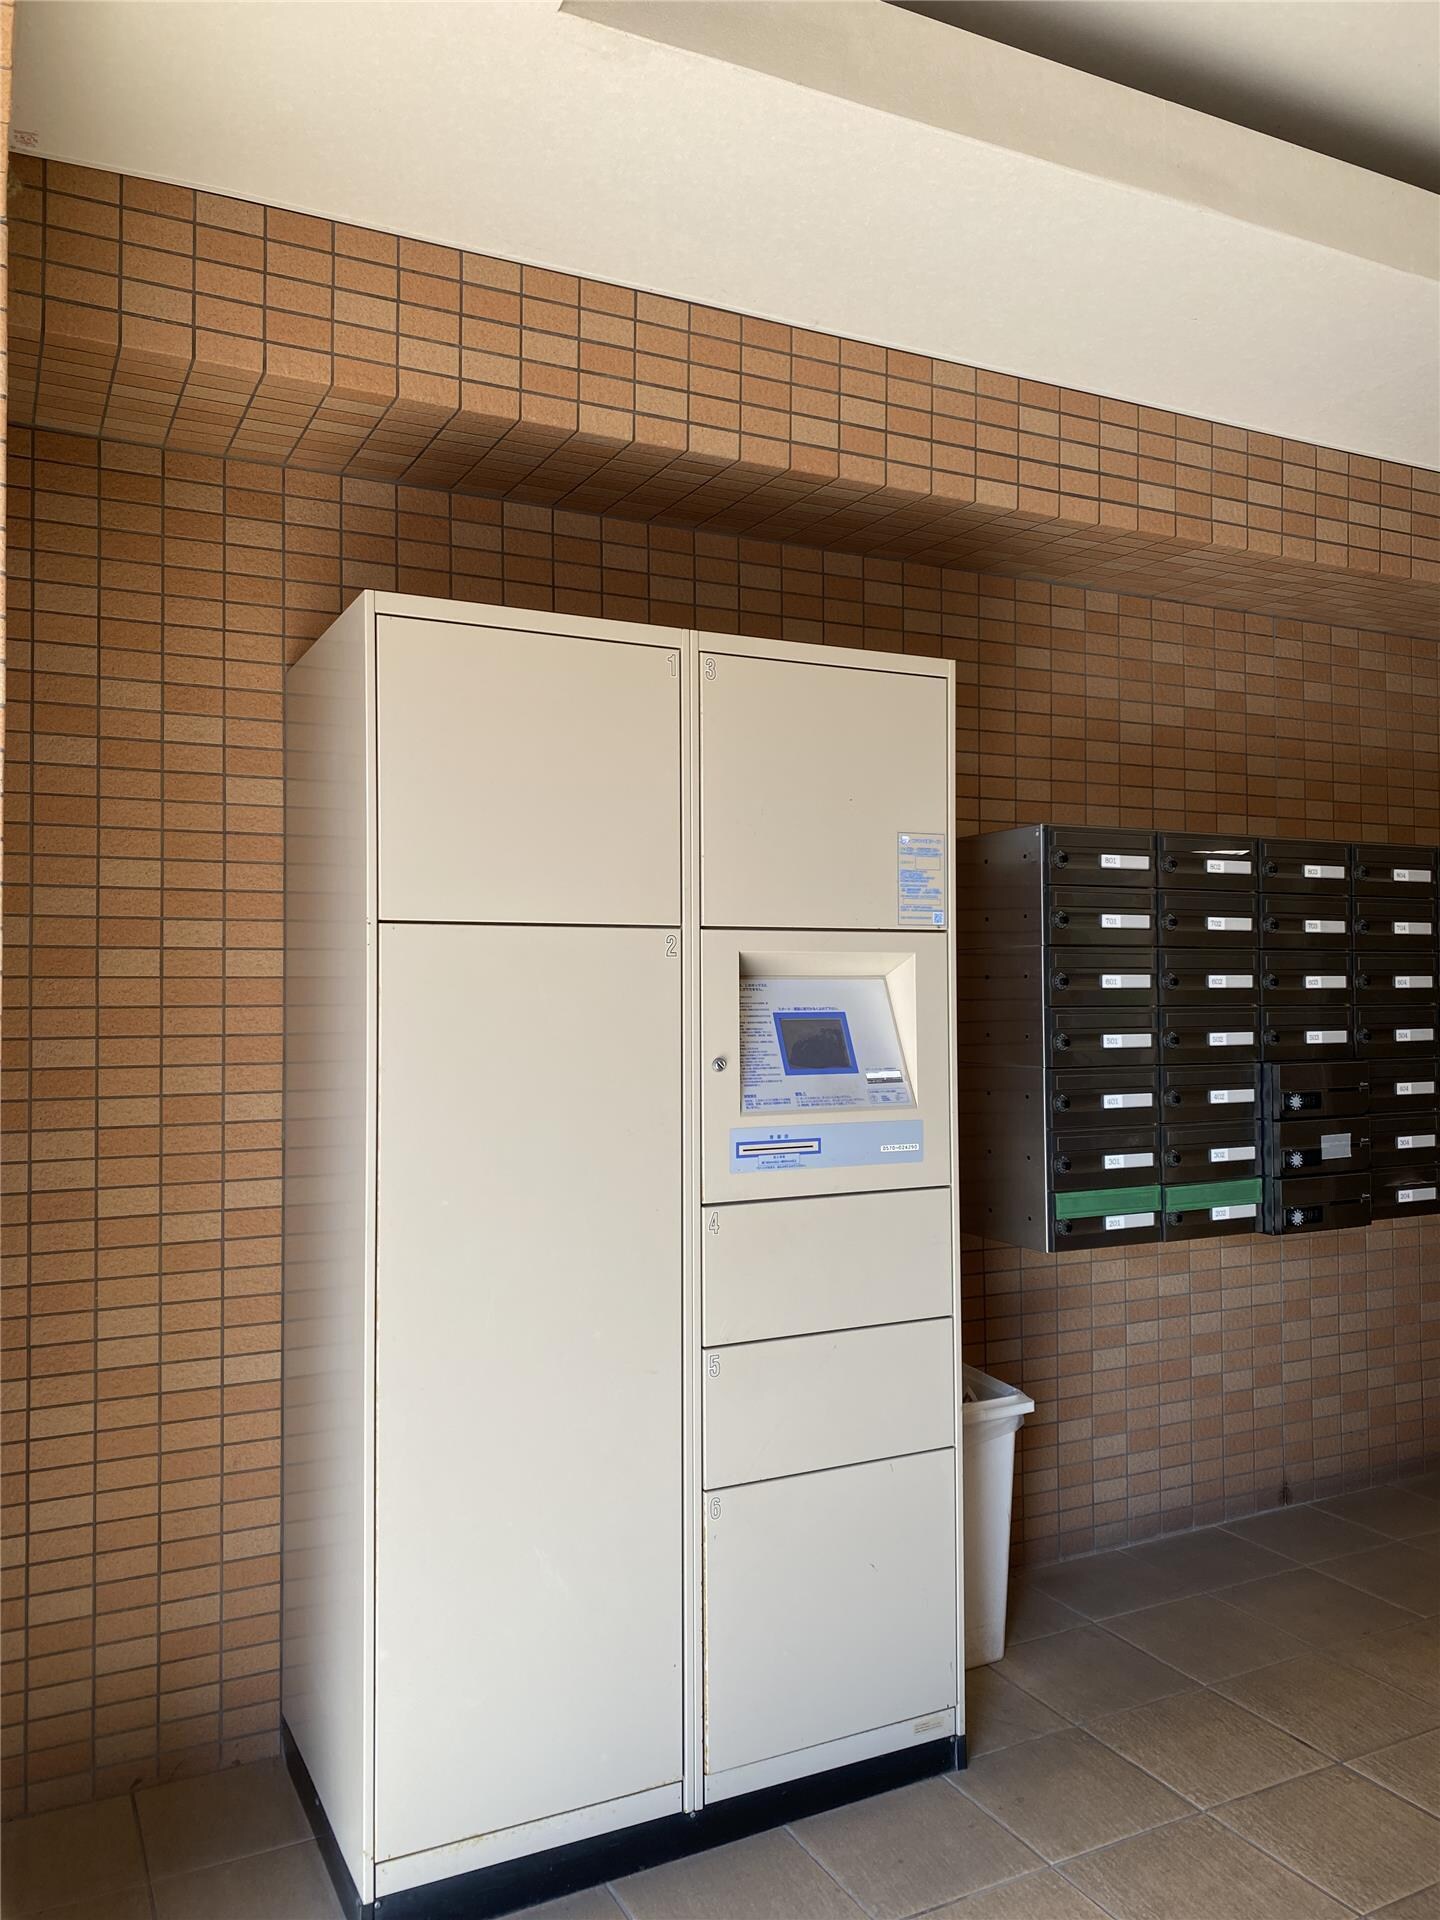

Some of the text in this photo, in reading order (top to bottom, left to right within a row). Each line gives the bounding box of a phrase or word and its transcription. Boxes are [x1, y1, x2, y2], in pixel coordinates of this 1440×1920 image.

[667, 653, 677, 677] 1
[705, 657, 717, 681] 3
[665, 934, 678, 957] 2
[708, 1211, 720, 1235] 4
[708, 1353, 721, 1378] 5
[709, 1496, 721, 1520] 6
